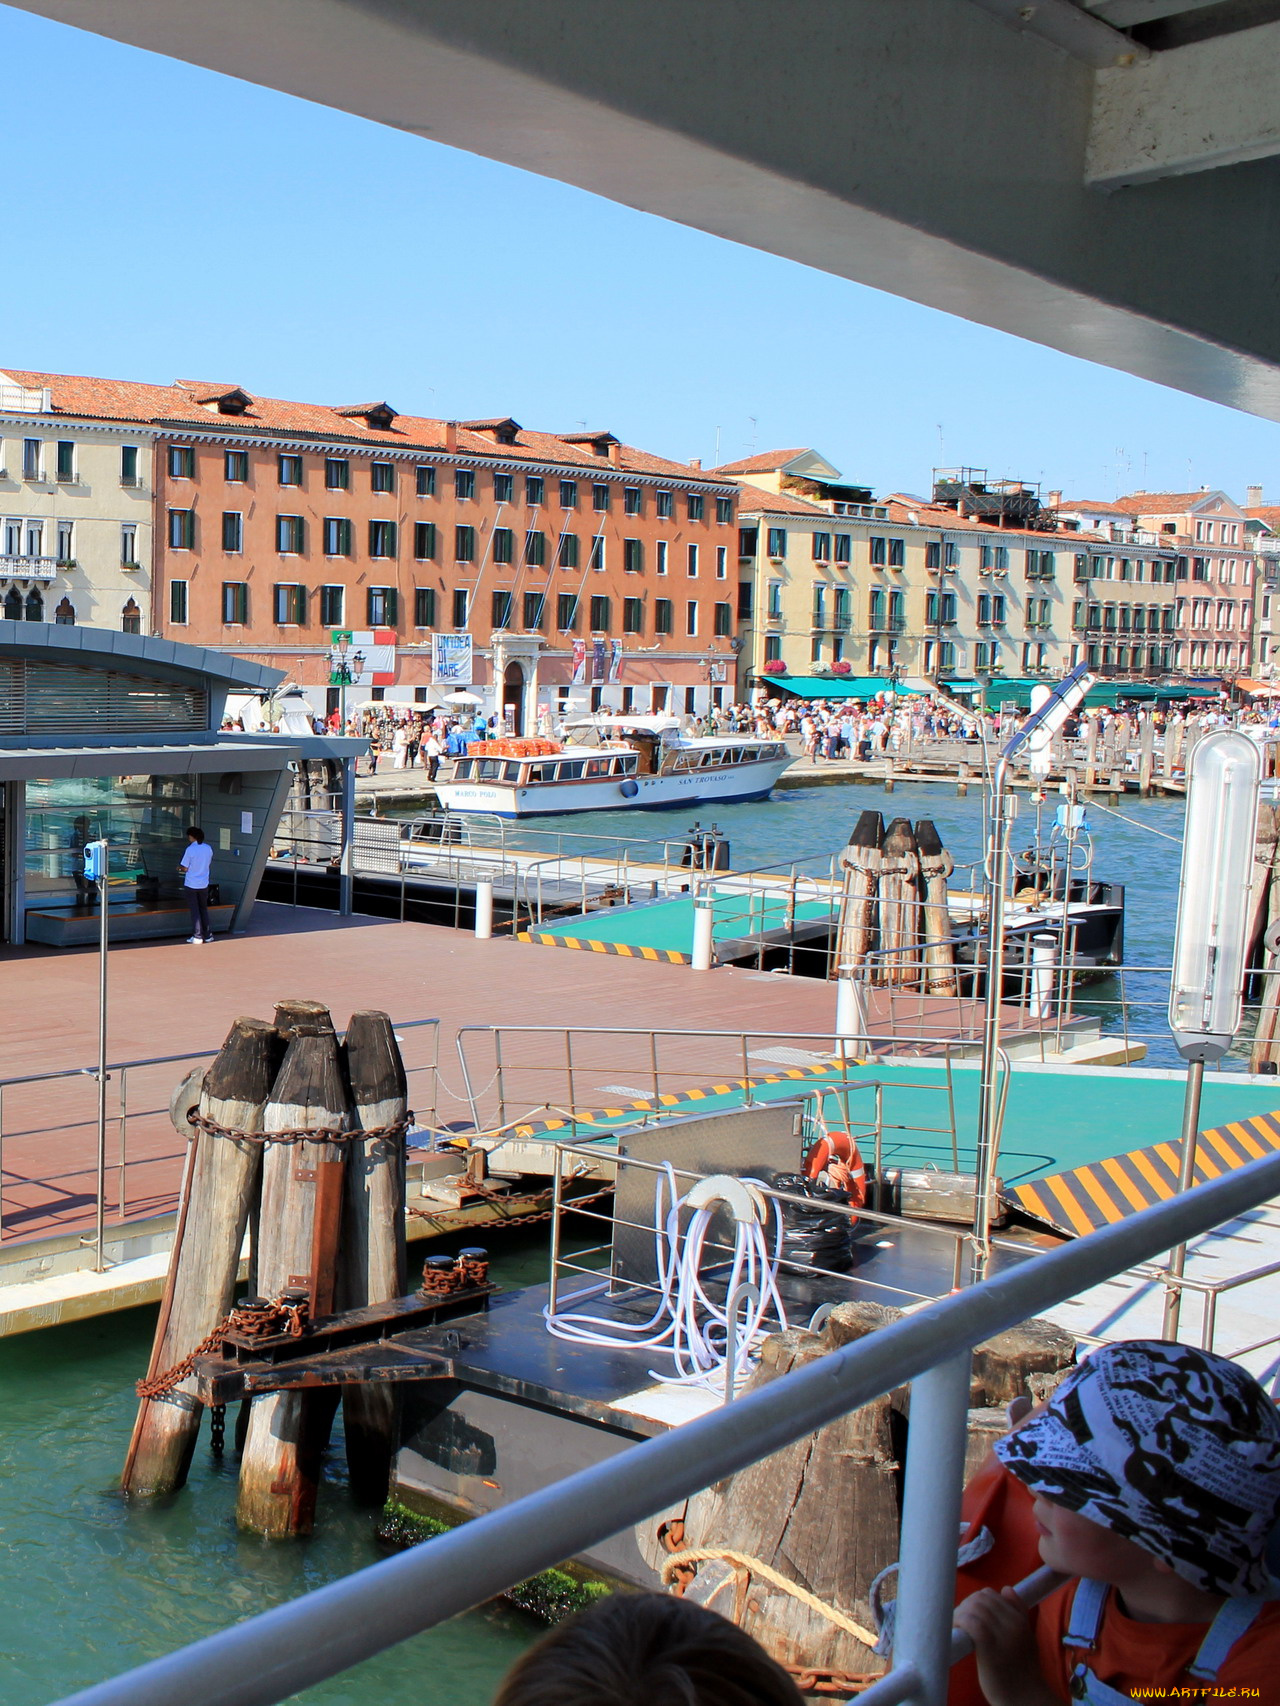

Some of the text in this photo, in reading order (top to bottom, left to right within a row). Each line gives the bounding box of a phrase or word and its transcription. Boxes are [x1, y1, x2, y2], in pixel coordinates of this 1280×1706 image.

[437, 649, 447, 663] DI
[437, 663, 459, 677] MARE
[695, 774, 727, 783] TROVASO
[455, 790, 497, 799] MARCO POLO
